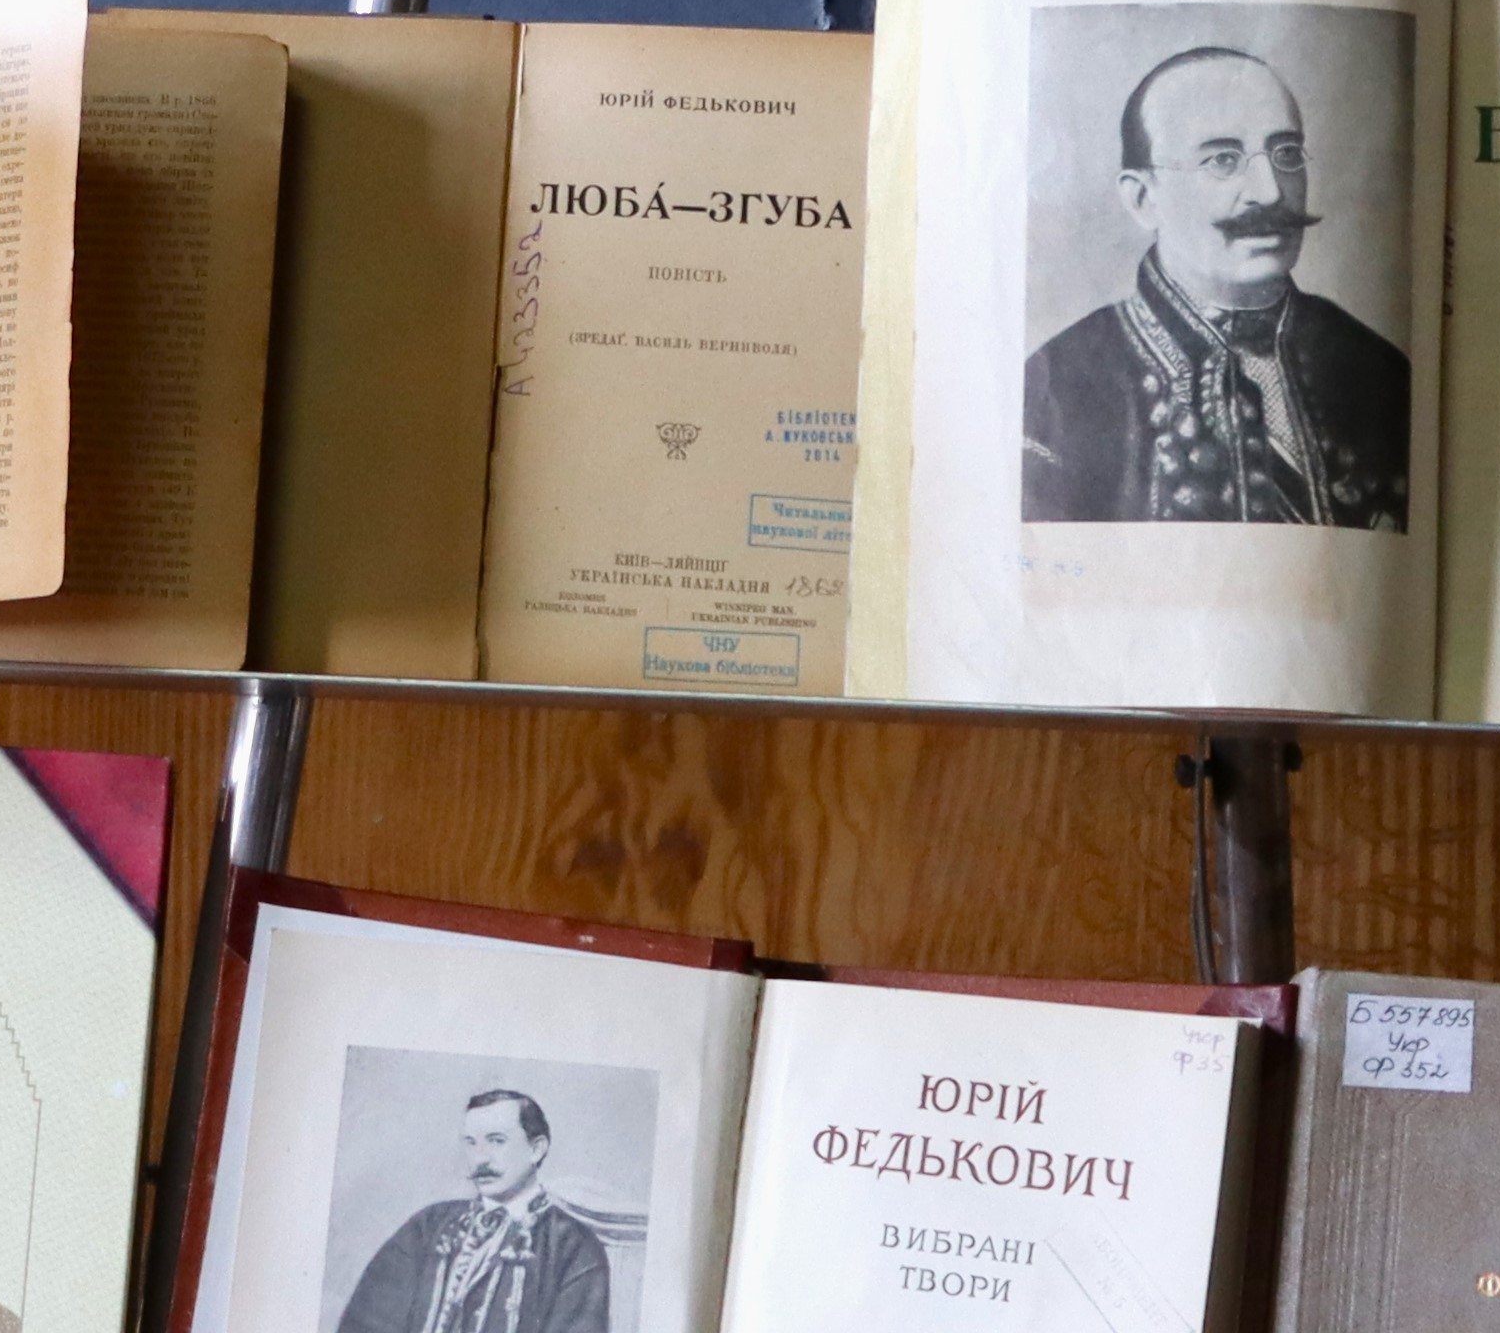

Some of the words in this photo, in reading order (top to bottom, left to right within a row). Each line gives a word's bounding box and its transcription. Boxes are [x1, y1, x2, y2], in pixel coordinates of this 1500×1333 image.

[600, 90, 654, 108] ЮРІЙ
[663, 96, 796, 115] ФЕДЬКОВИЧ
[648, 266, 727, 283] ПОВІСТЬ
[569, 568, 672, 588] УКРАЇНСЬКА
[681, 577, 770, 593] НАКЛАДНЯ
[918, 1074, 1049, 1125] ЮРІЙ
[812, 1124, 1134, 1201] ФЕДЬКОВИЧ
[880, 1224, 1036, 1266] ВИБРАНІ
[900, 1265, 1012, 1303] ТВОРИ
